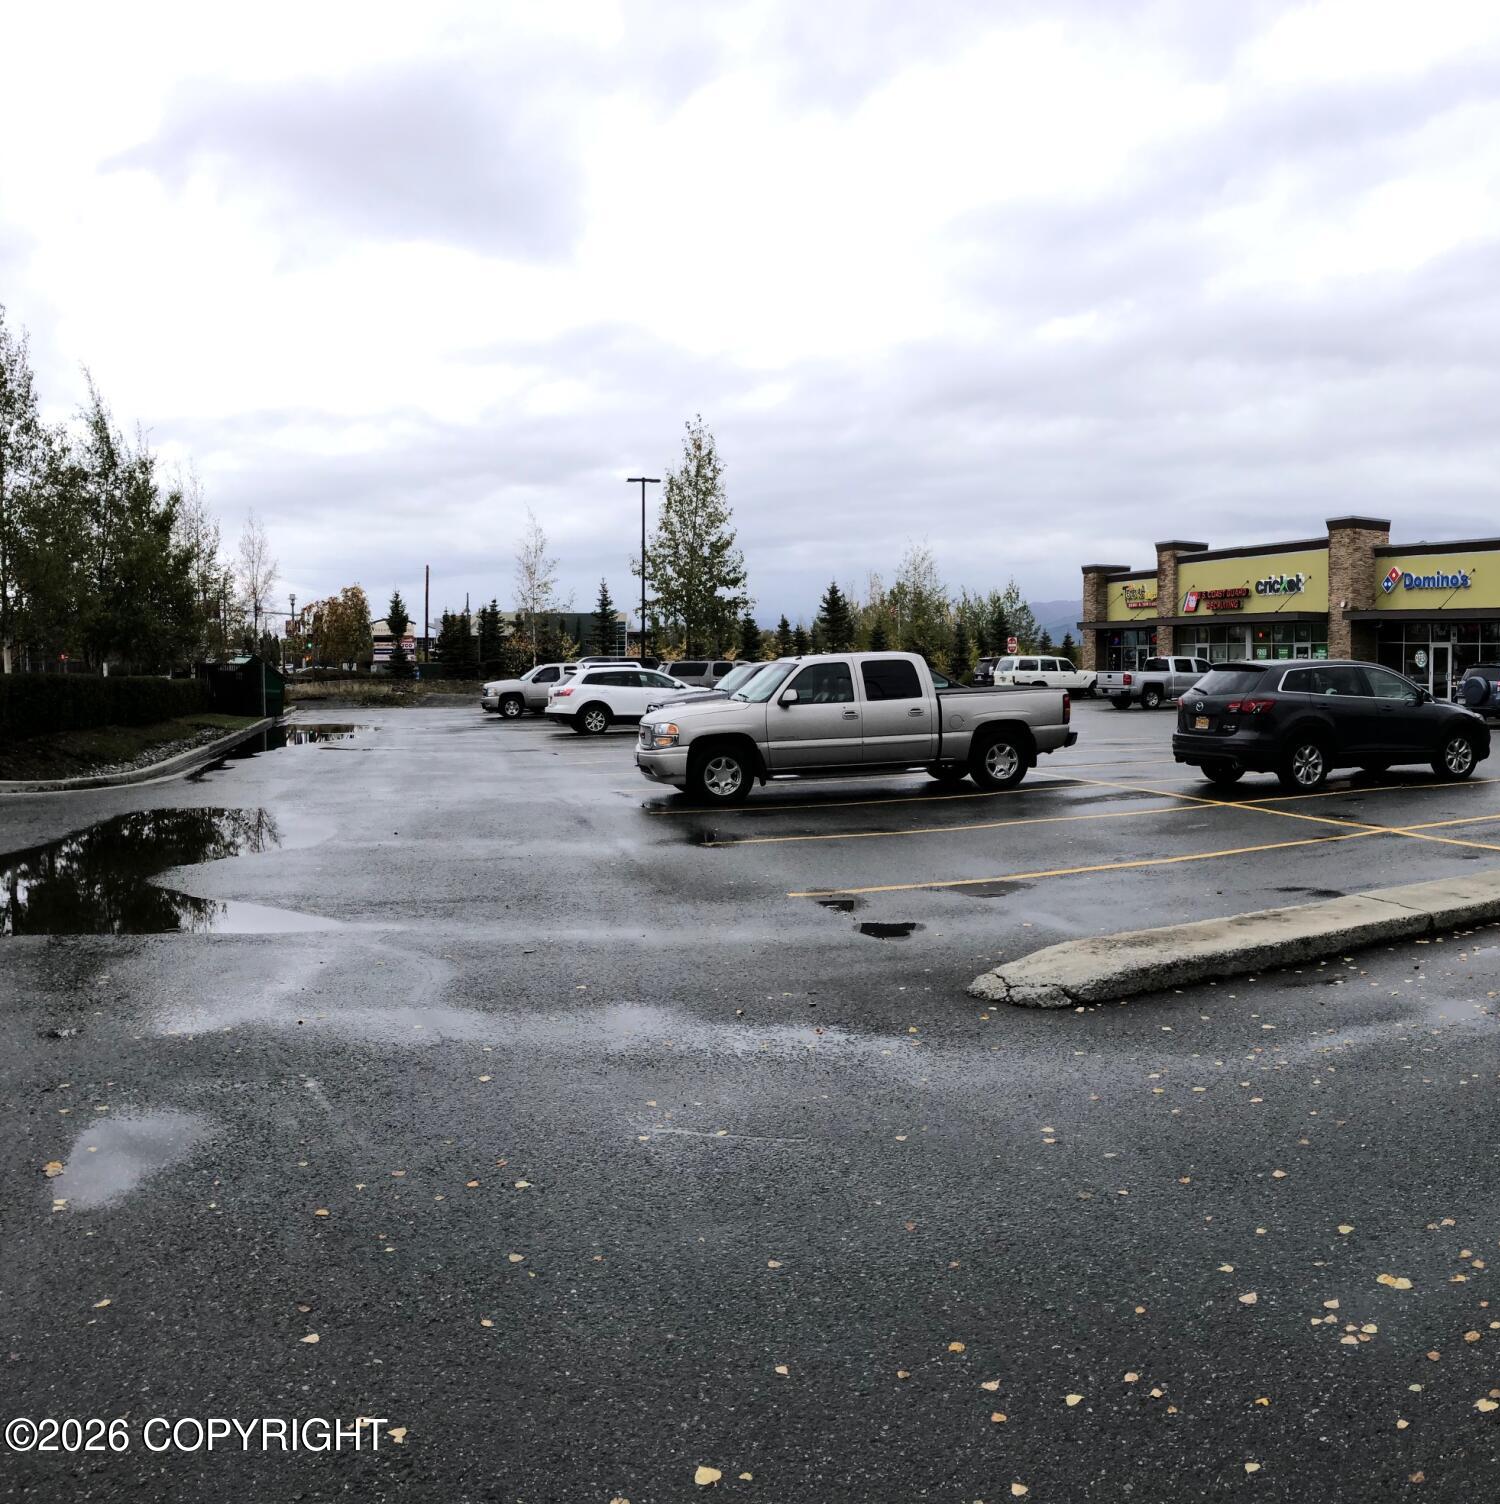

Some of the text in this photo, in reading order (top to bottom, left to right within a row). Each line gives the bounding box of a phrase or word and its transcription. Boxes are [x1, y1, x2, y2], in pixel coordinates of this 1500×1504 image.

[1255, 573, 1304, 595] cricket
[1403, 570, 1471, 589] Domino's
[1207, 590, 1226, 598] COAST
[1226, 588, 1247, 597] GUARD
